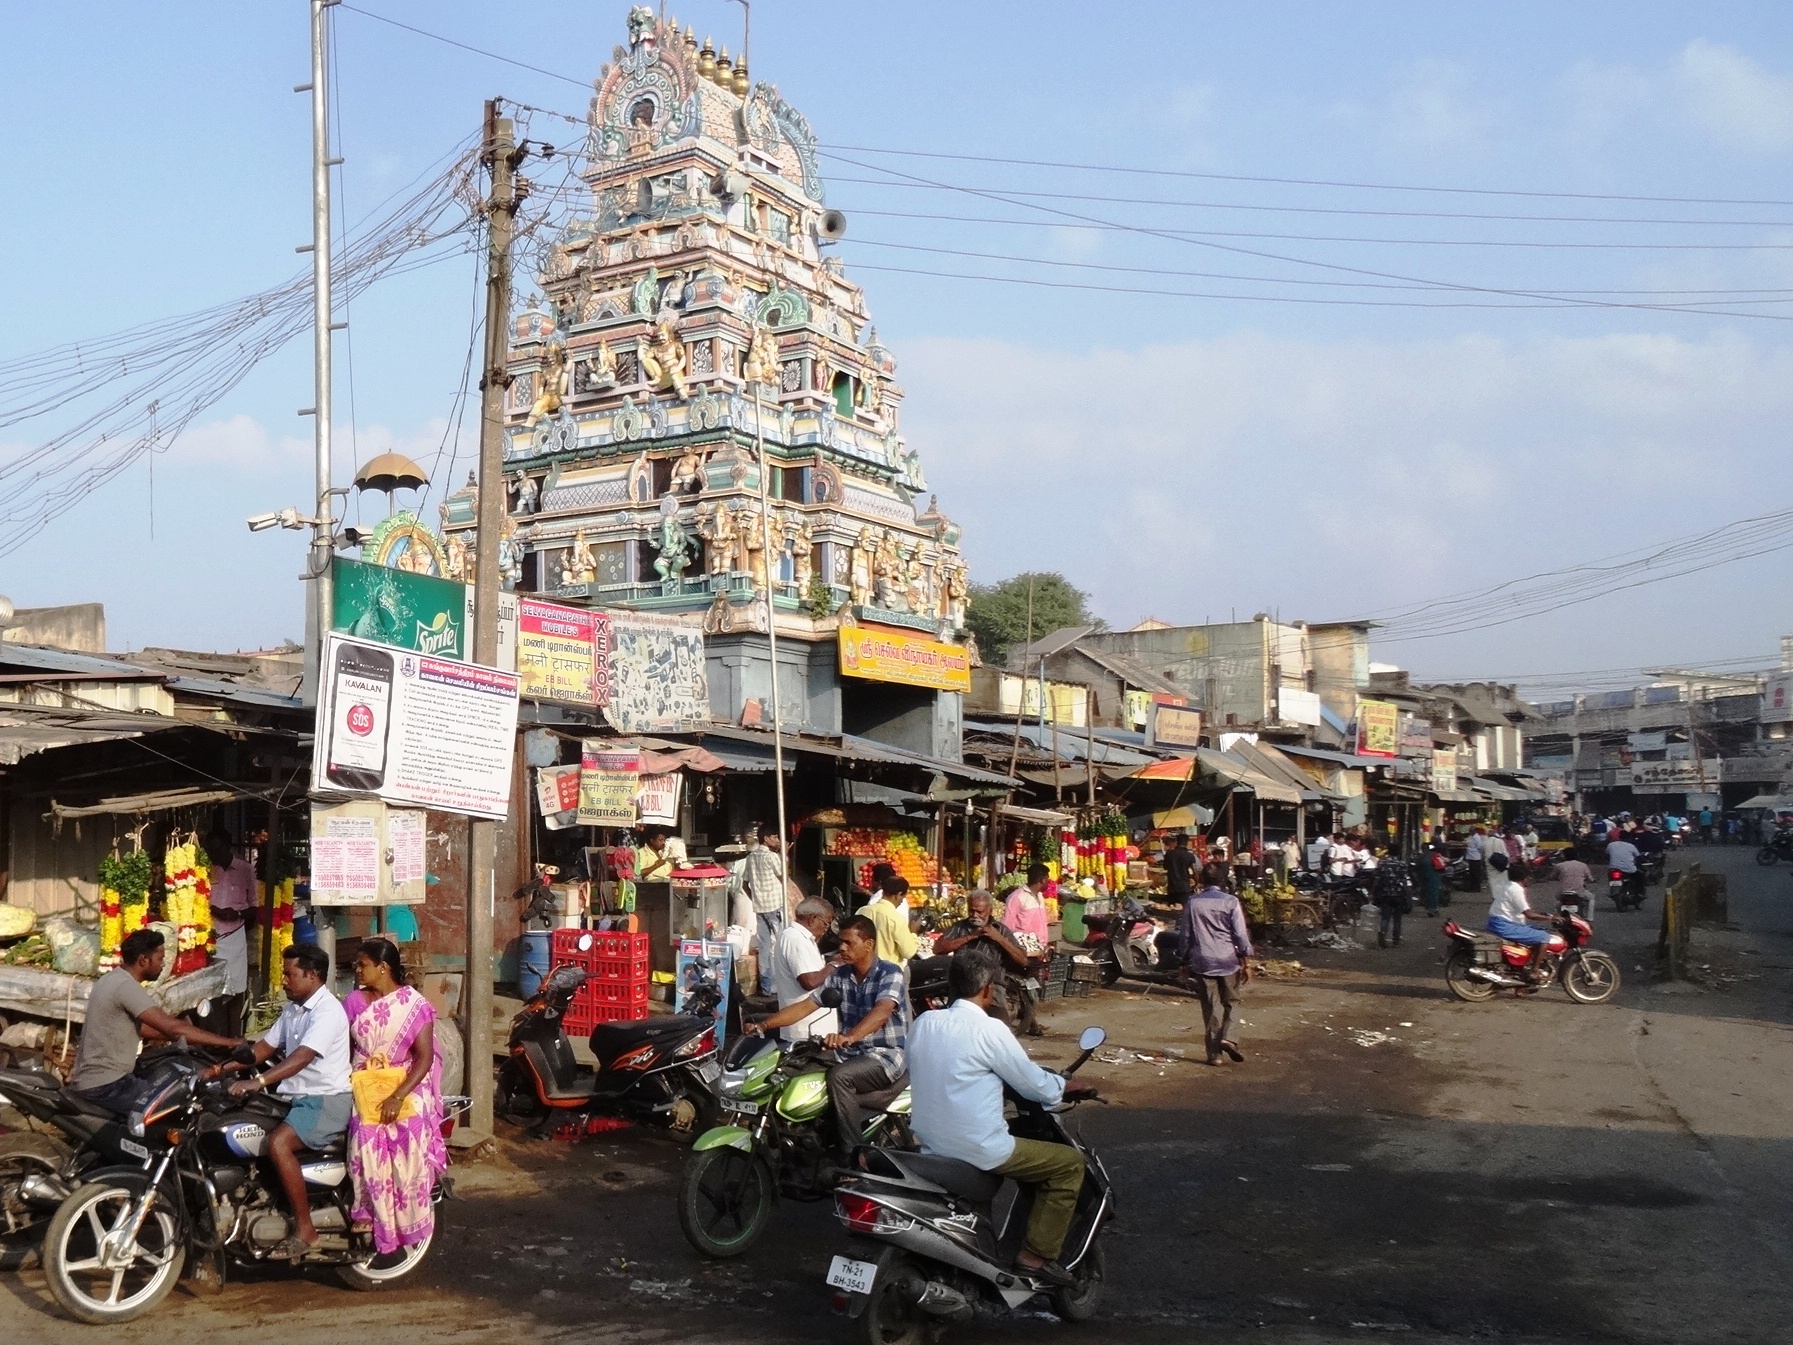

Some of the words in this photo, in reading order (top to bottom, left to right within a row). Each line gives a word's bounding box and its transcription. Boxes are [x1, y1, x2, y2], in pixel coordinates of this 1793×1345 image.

[419, 629, 454, 654] Sprite
[523, 638, 546, 649] மணி
[524, 652, 548, 668] मनी
[595, 618, 608, 704] XEROX
[860, 637, 873, 658] ஸ்ரீ
[874, 641, 899, 659] செல்வ
[901, 644, 938, 666] விநாயகர்
[939, 652, 965, 671] ஆலயம்
[345, 679, 382, 693] KAVALAN
[545, 674, 555, 684] EB
[556, 675, 573, 685] BILL
[549, 687, 593, 701] ஜெராக்ஸ்
[353, 713, 369, 727] SOS
[590, 796, 601, 804] EB
[604, 797, 621, 805] BILL
[579, 805, 632, 818] ஜெராக்ஸ்
[802, 1080, 822, 1090] TVS
[235, 1131, 264, 1139] HOND
[948, 1211, 978, 1230] Scooty
[842, 1264, 864, 1277] TN-21
[833, 1275, 866, 1291] BH-3543
